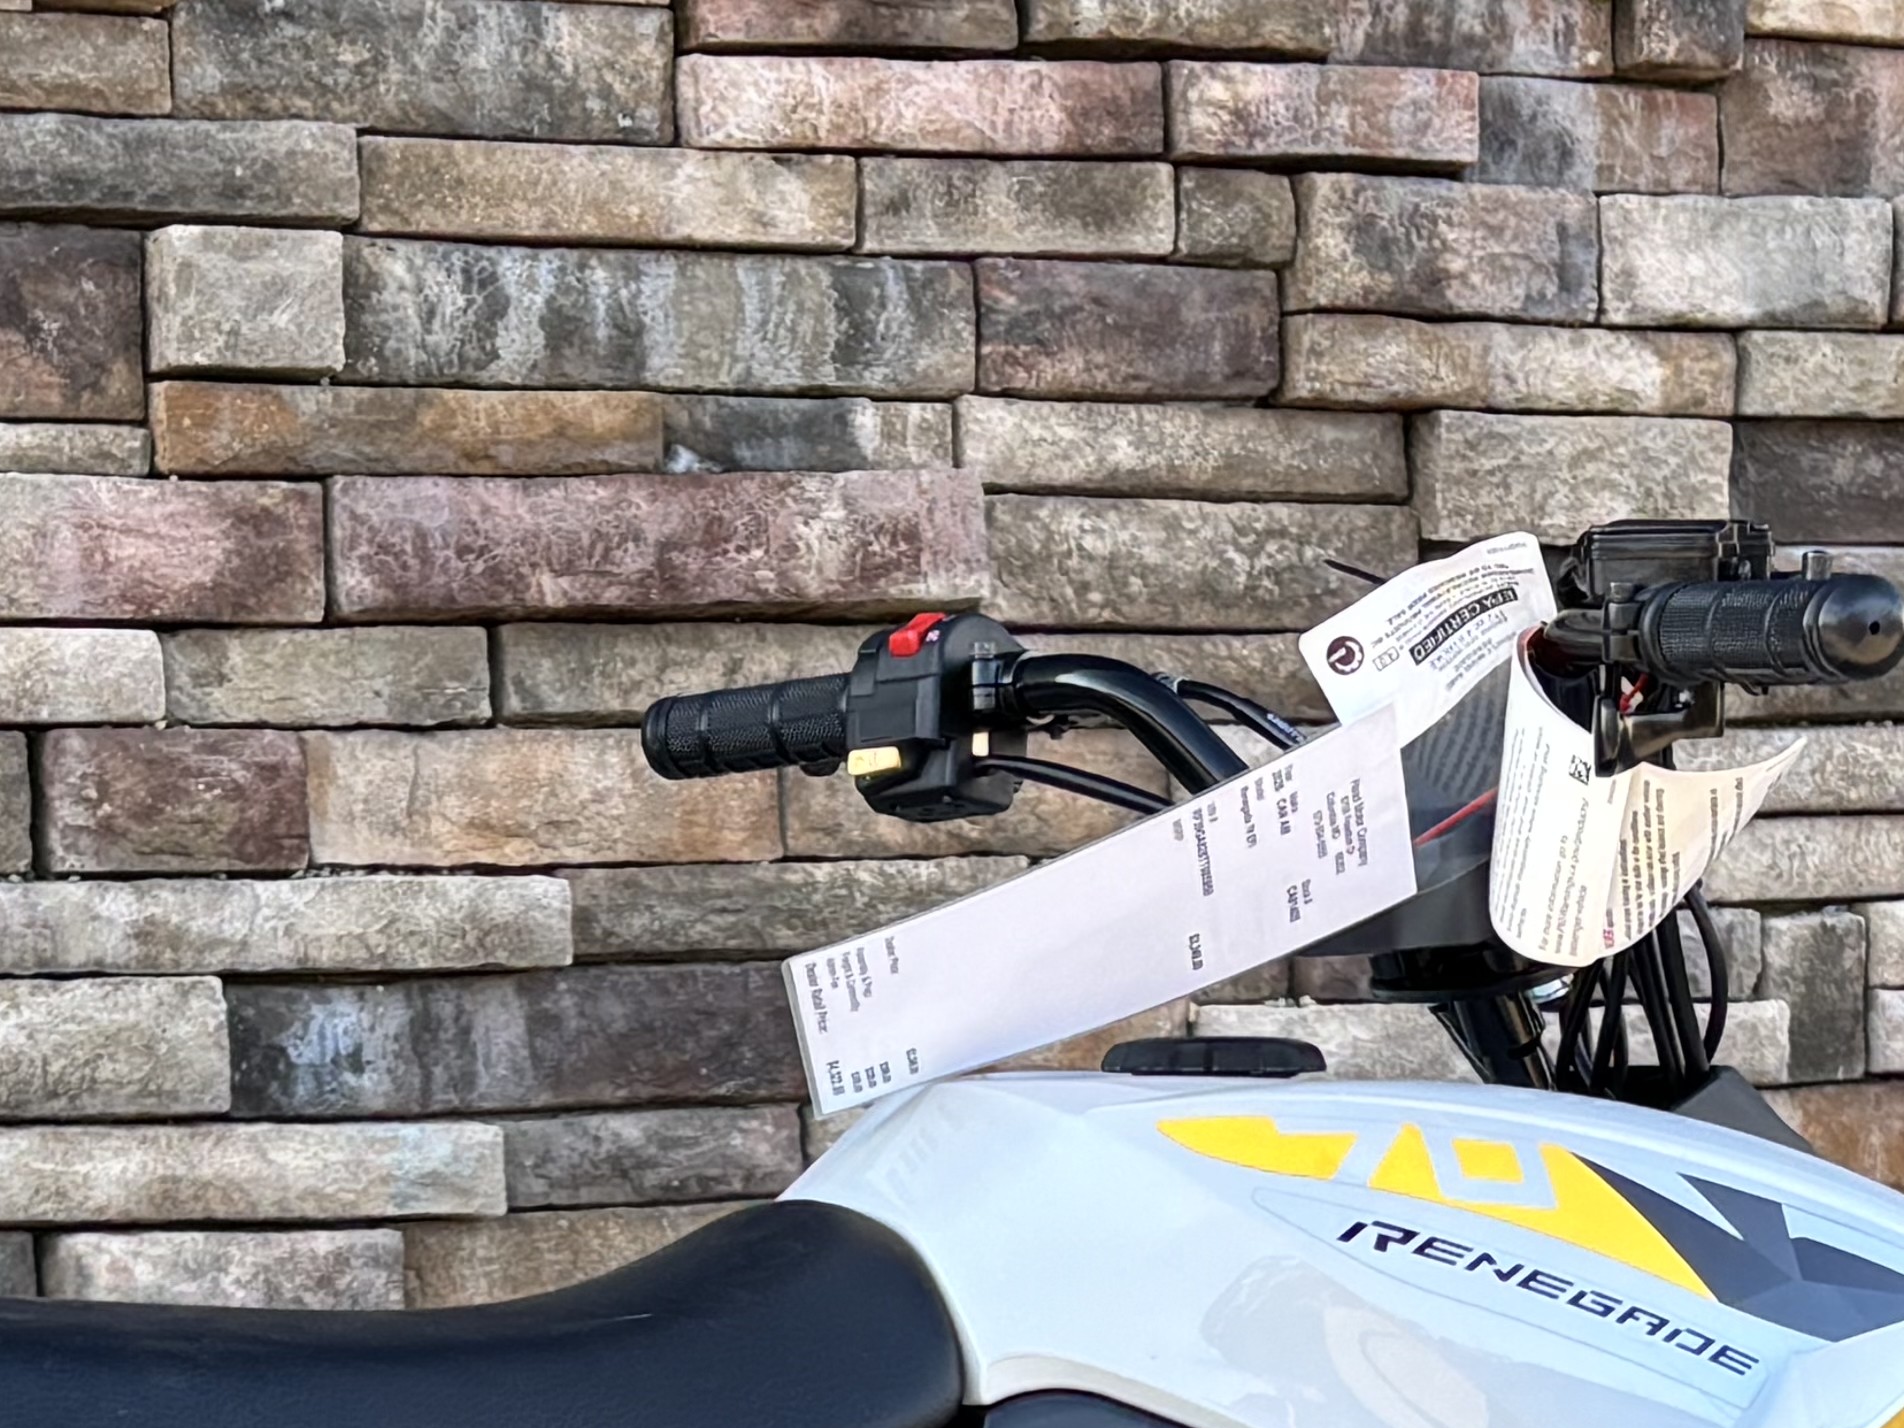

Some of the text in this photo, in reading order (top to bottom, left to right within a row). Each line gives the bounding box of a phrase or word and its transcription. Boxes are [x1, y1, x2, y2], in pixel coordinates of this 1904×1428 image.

[1480, 589, 1516, 609] EPA
[1413, 600, 1482, 661] CERTIFIED
[1336, 1220, 1761, 1377] RENEGADE
